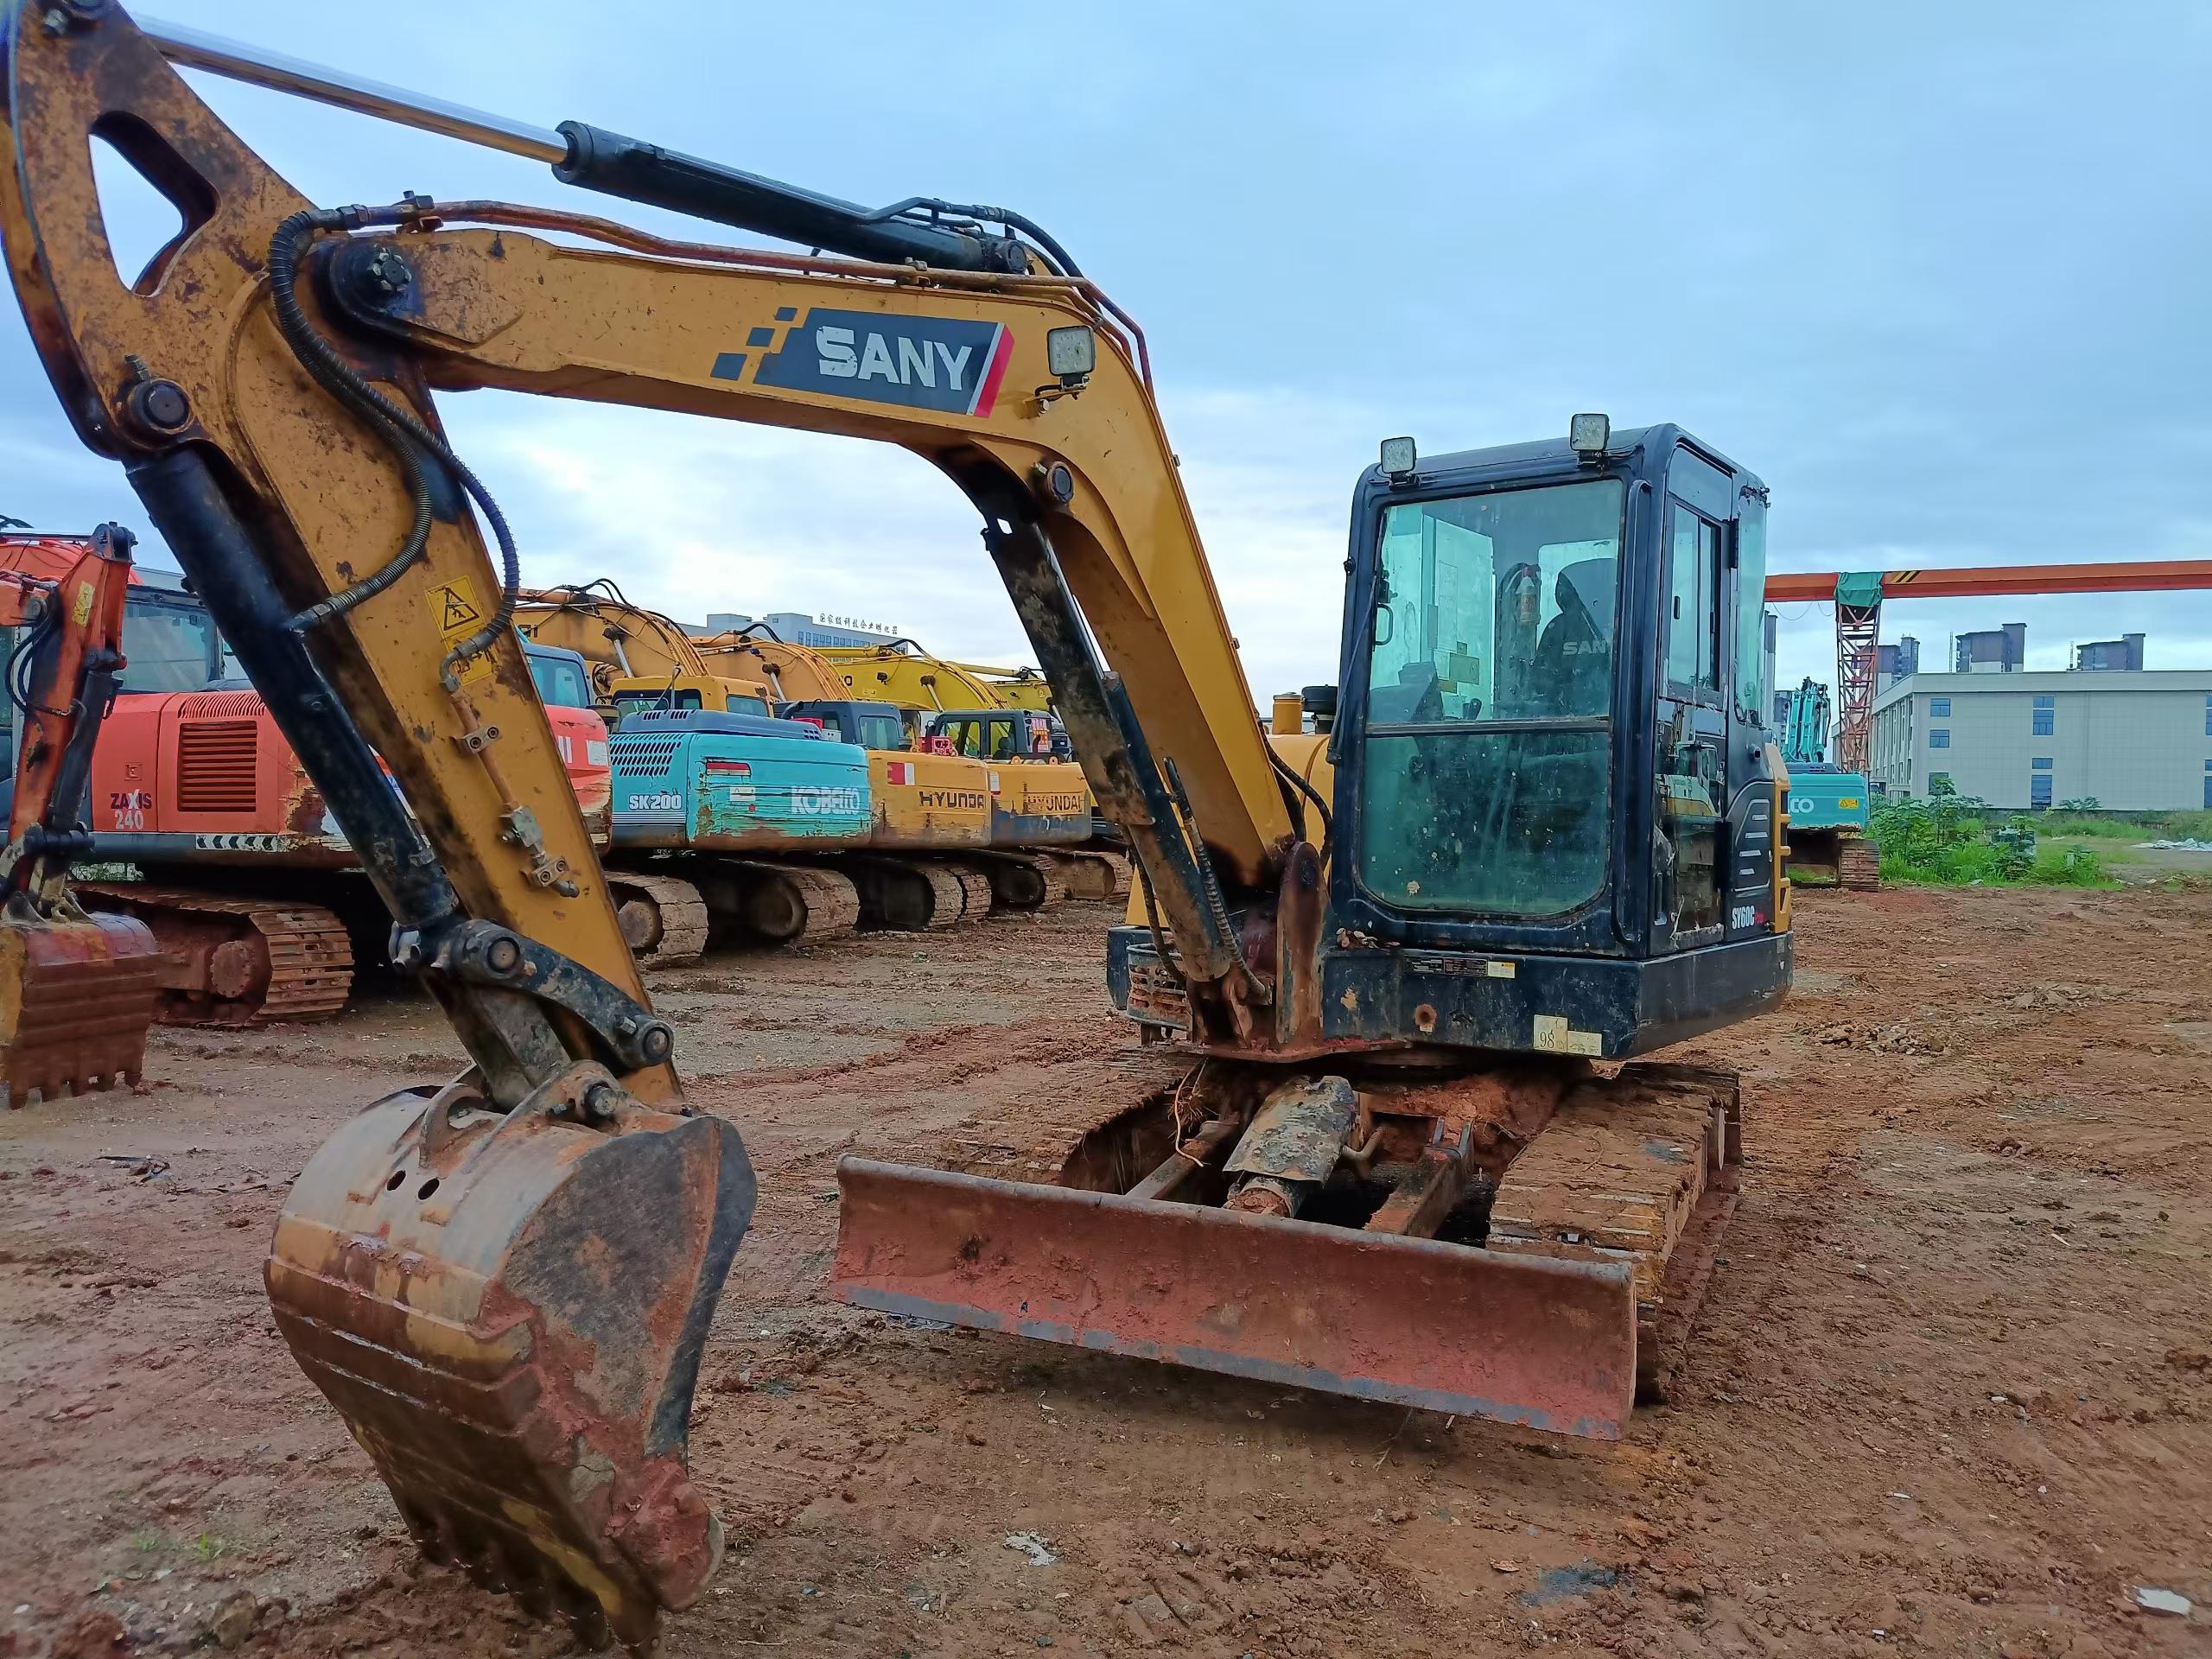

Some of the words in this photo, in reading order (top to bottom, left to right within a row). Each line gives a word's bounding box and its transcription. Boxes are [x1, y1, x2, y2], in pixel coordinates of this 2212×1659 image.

[816, 325, 973, 391] SANY
[1562, 639, 1607, 656] SAN
[110, 788, 153, 810] ZAXIS
[628, 794, 683, 810] SK200
[918, 791, 987, 810] HYUNDA
[114, 809, 144, 830] 240
